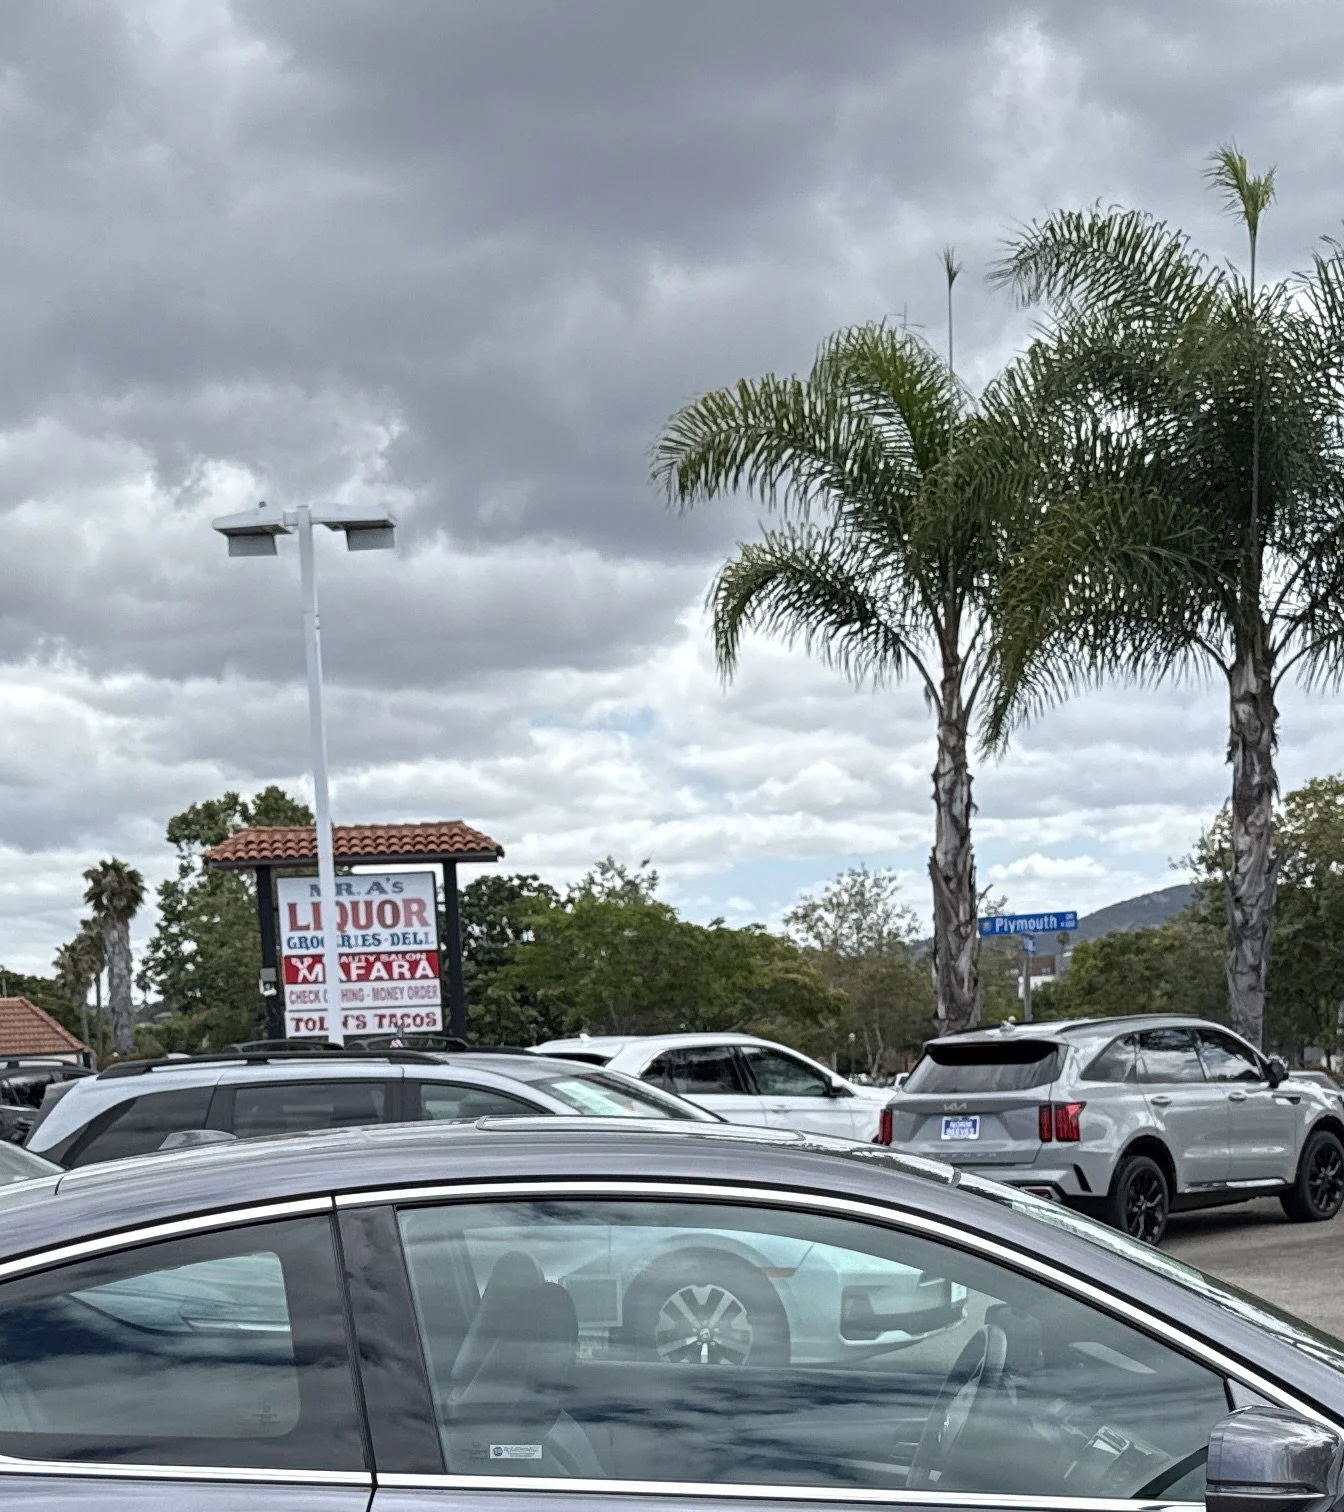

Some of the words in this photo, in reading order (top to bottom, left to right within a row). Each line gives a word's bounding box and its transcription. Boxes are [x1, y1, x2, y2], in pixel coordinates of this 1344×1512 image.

[287, 897, 431, 933] LIQUOR
[996, 915, 1057, 933] Plymouth
[289, 990, 321, 1005] CHECK
[372, 986, 405, 1002] MONEY
[407, 985, 438, 1000] ORDER
[374, 1012, 437, 1029] TACOS
